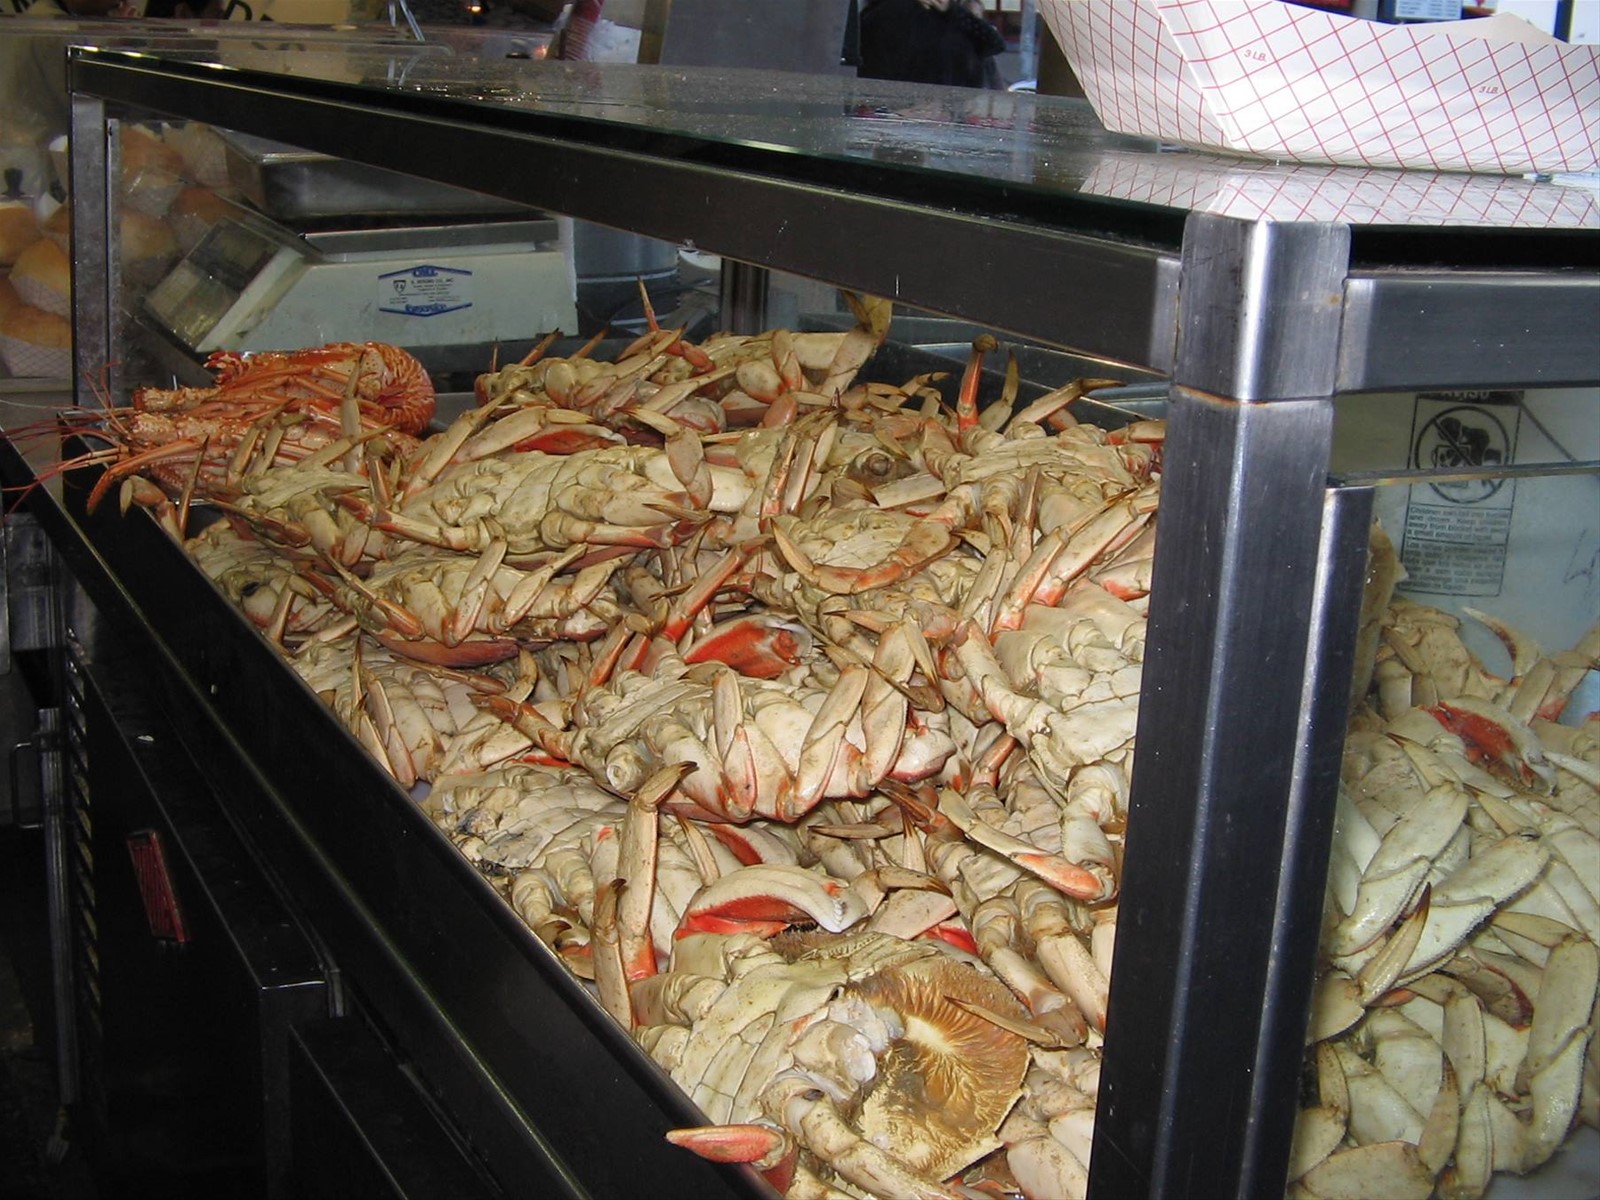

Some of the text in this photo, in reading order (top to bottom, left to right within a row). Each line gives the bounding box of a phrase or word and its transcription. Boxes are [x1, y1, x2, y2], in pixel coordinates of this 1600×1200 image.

[1244, 49, 1252, 58] 3
[1410, 507, 1442, 515] Children
[1408, 522, 1427, 530] away
